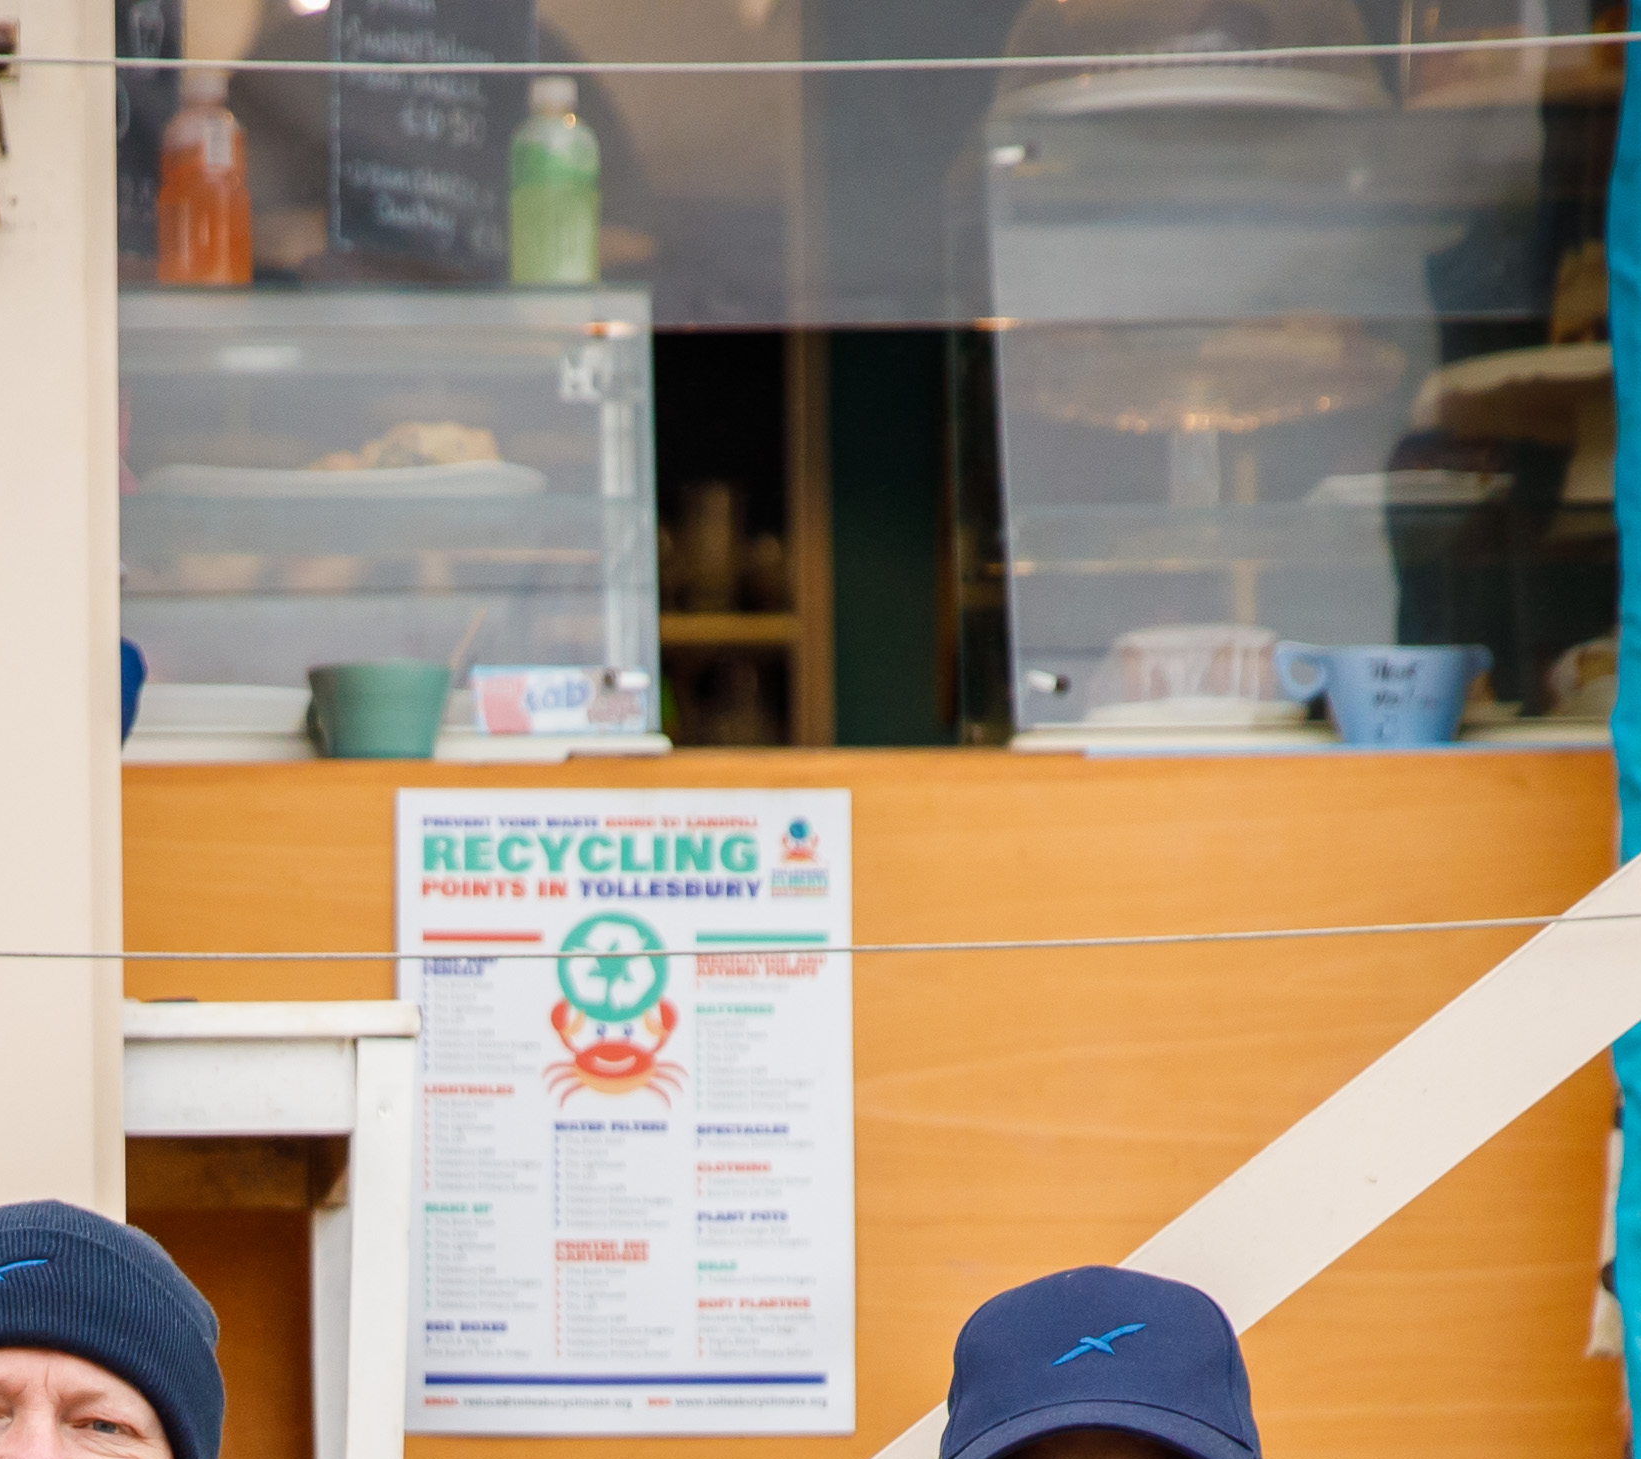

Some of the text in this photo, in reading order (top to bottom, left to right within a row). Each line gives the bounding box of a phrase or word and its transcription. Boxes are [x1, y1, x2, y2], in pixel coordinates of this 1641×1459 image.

[422, 833, 759, 872] RECYCLING
[422, 878, 526, 897] POINTS
[538, 878, 568, 897] IN
[579, 878, 762, 898] TOLLESBURY
